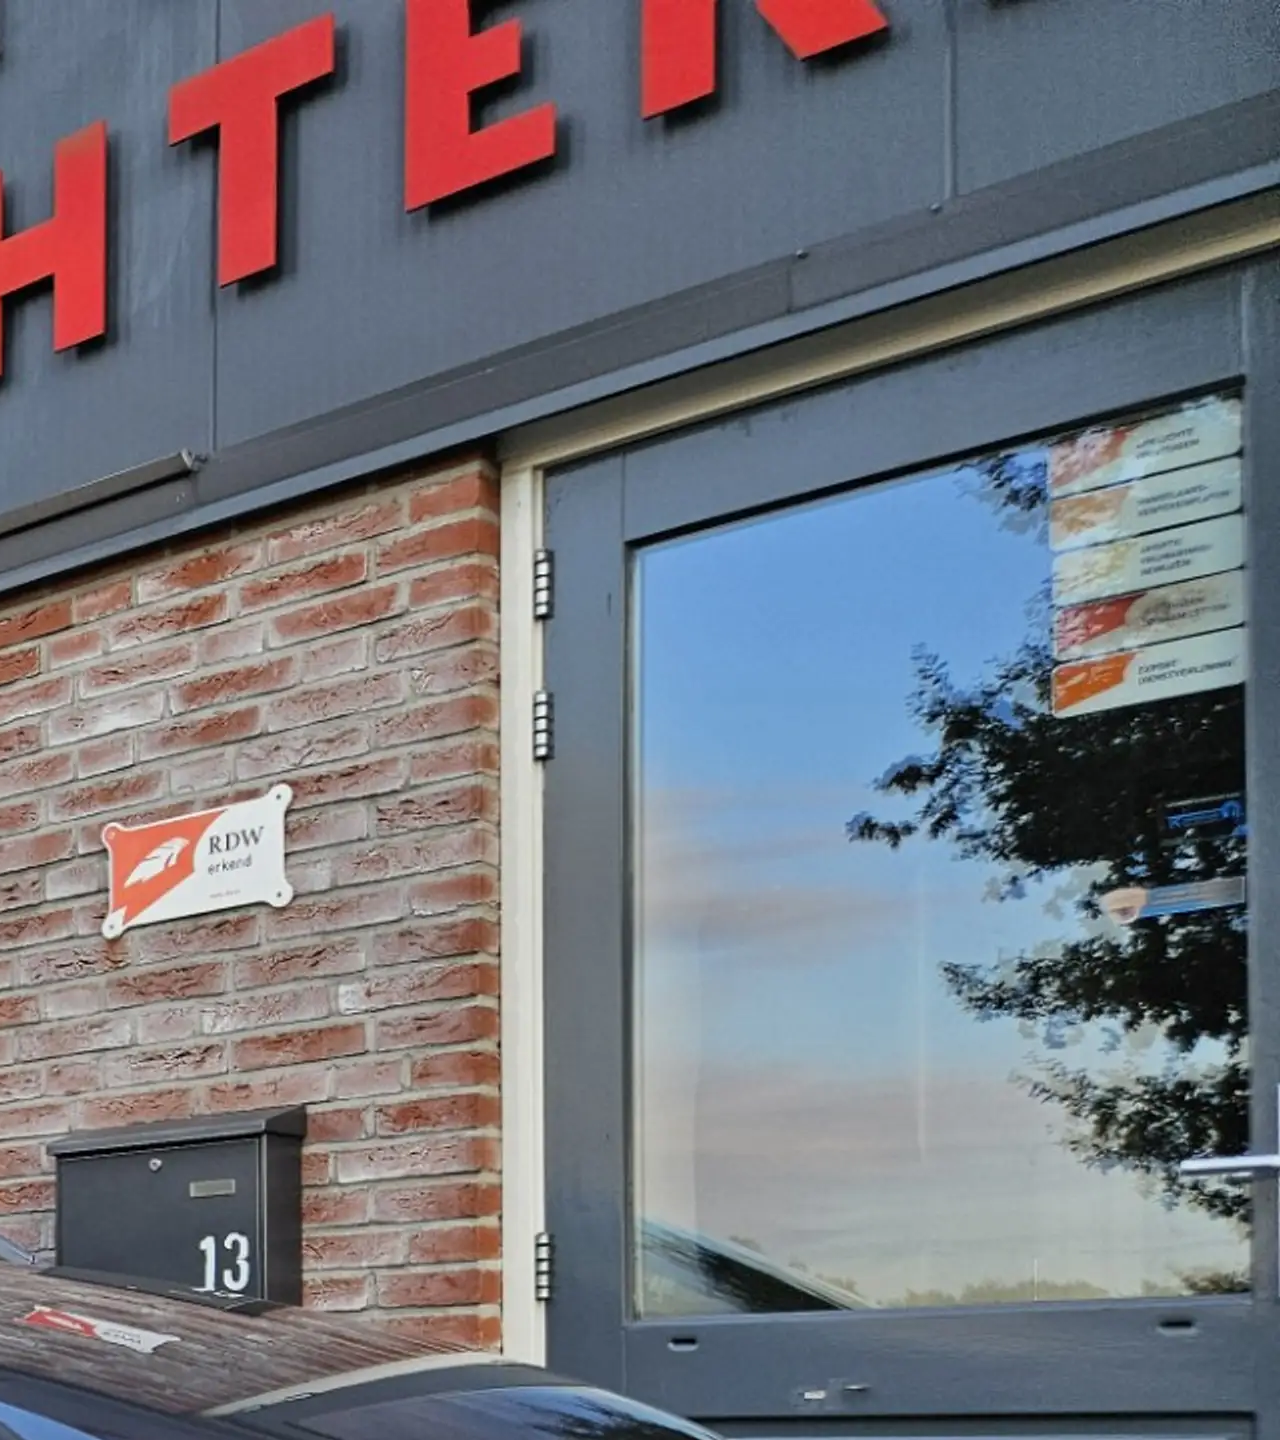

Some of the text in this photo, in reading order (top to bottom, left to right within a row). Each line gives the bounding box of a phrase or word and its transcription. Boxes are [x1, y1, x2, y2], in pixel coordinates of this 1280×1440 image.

[209, 826, 264, 853] RDW
[208, 855, 252, 875] erkend
[199, 1232, 250, 1291] 13
